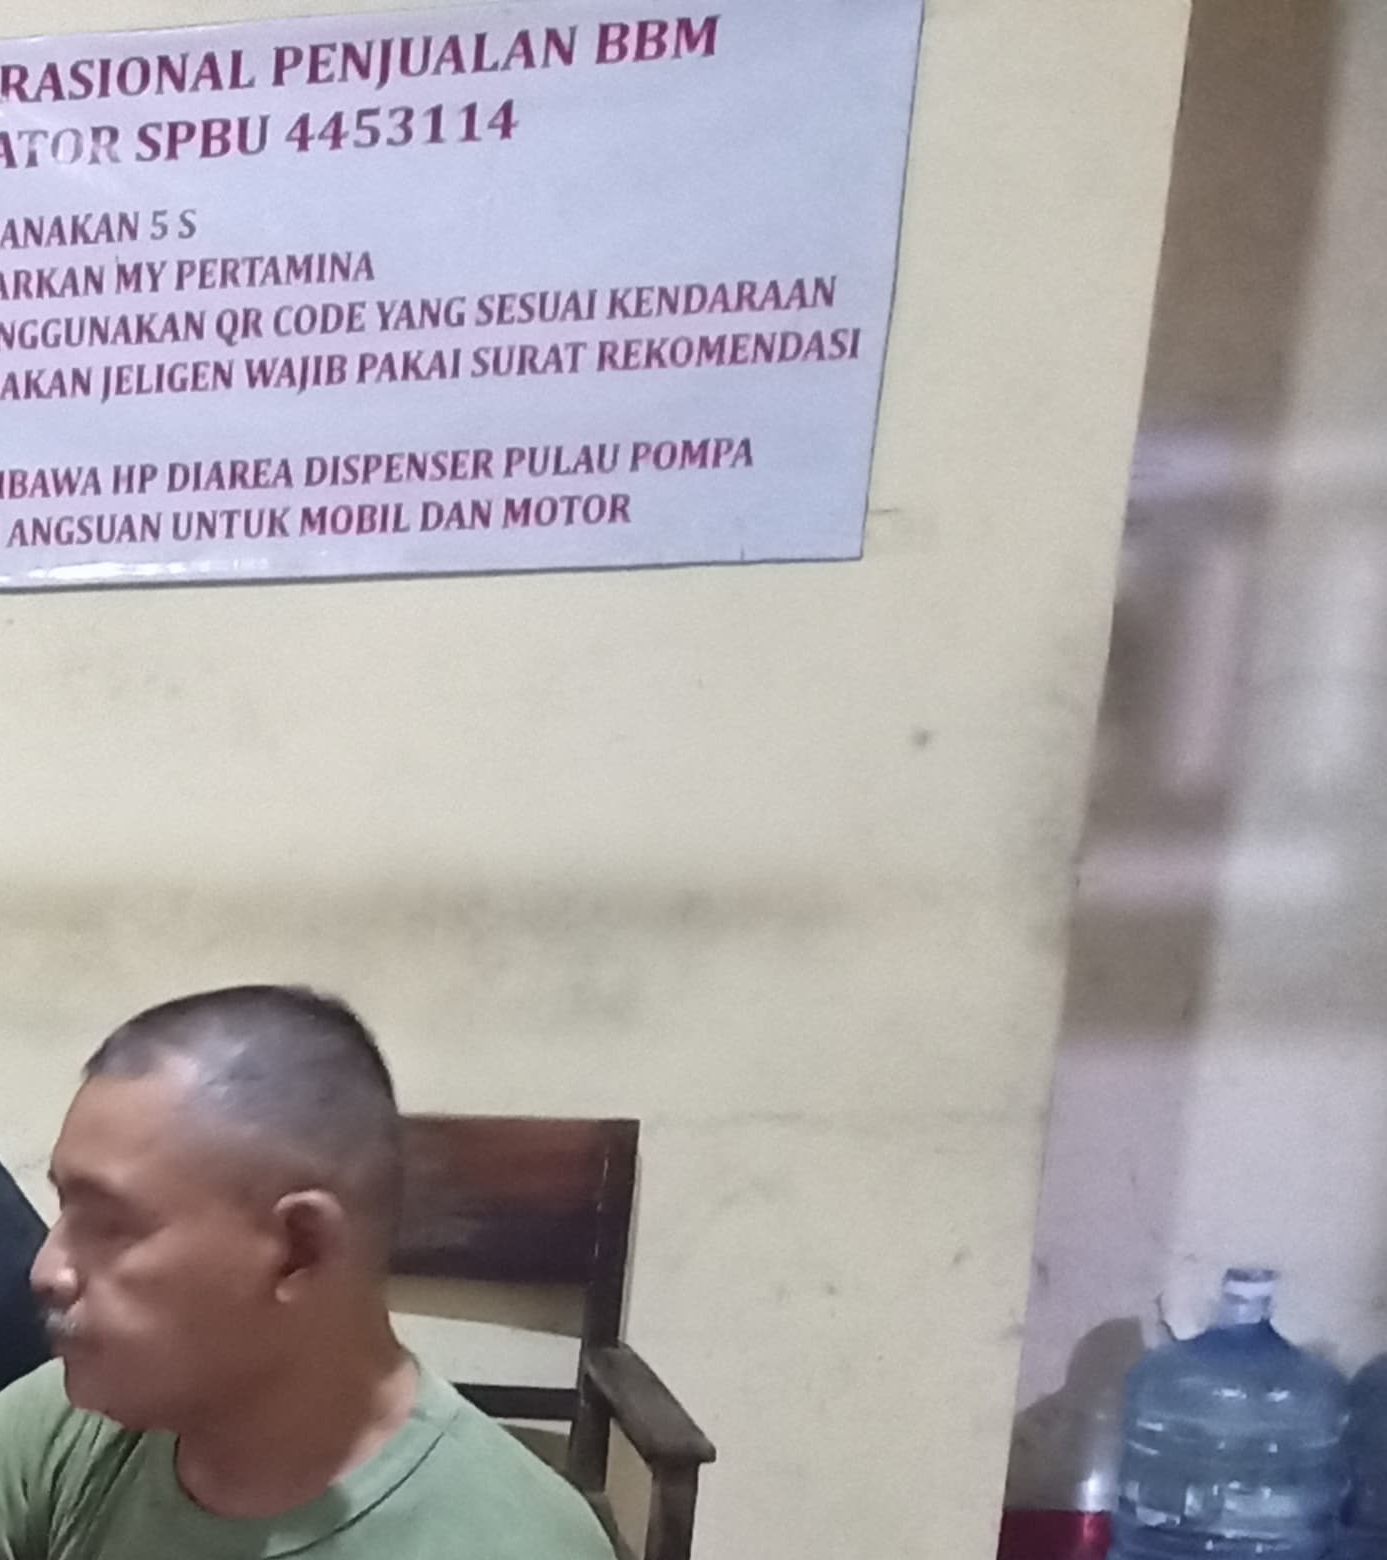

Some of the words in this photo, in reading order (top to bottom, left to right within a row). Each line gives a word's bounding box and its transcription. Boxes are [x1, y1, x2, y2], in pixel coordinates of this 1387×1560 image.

[272, 25, 577, 90] PENJUALAN
[595, 14, 721, 64] BBM
[136, 115, 270, 162] SPBU
[285, 99, 519, 152] 4453114
[150, 209, 168, 240] 5
[178, 209, 196, 239] S
[115, 261, 167, 294] MY
[175, 251, 375, 291] PERTAMINA
[216, 308, 262, 347] QR
[274, 301, 366, 337] CODE
[376, 296, 466, 332] YANG
[475, 289, 597, 326] SESUAI
[606, 275, 837, 320] KENDARAAN
[101, 360, 233, 404] JELIGEN
[245, 355, 347, 395] WAJIB
[356, 348, 461, 384] PAKAI
[471, 342, 587, 378] SURAT
[597, 328, 861, 372] REKOMENDASI
[113, 464, 158, 495] HP
[167, 458, 293, 493] DIAREA
[305, 449, 493, 487] DISPENSER
[504, 443, 620, 478] PULAU
[630, 437, 753, 472] POMPA
[6, 512, 162, 548] ANGSUAN
[173, 507, 290, 541] UNTUK
[299, 503, 410, 536] MOBIL
[419, 500, 492, 532] DAN
[502, 494, 631, 529] MOTOR
